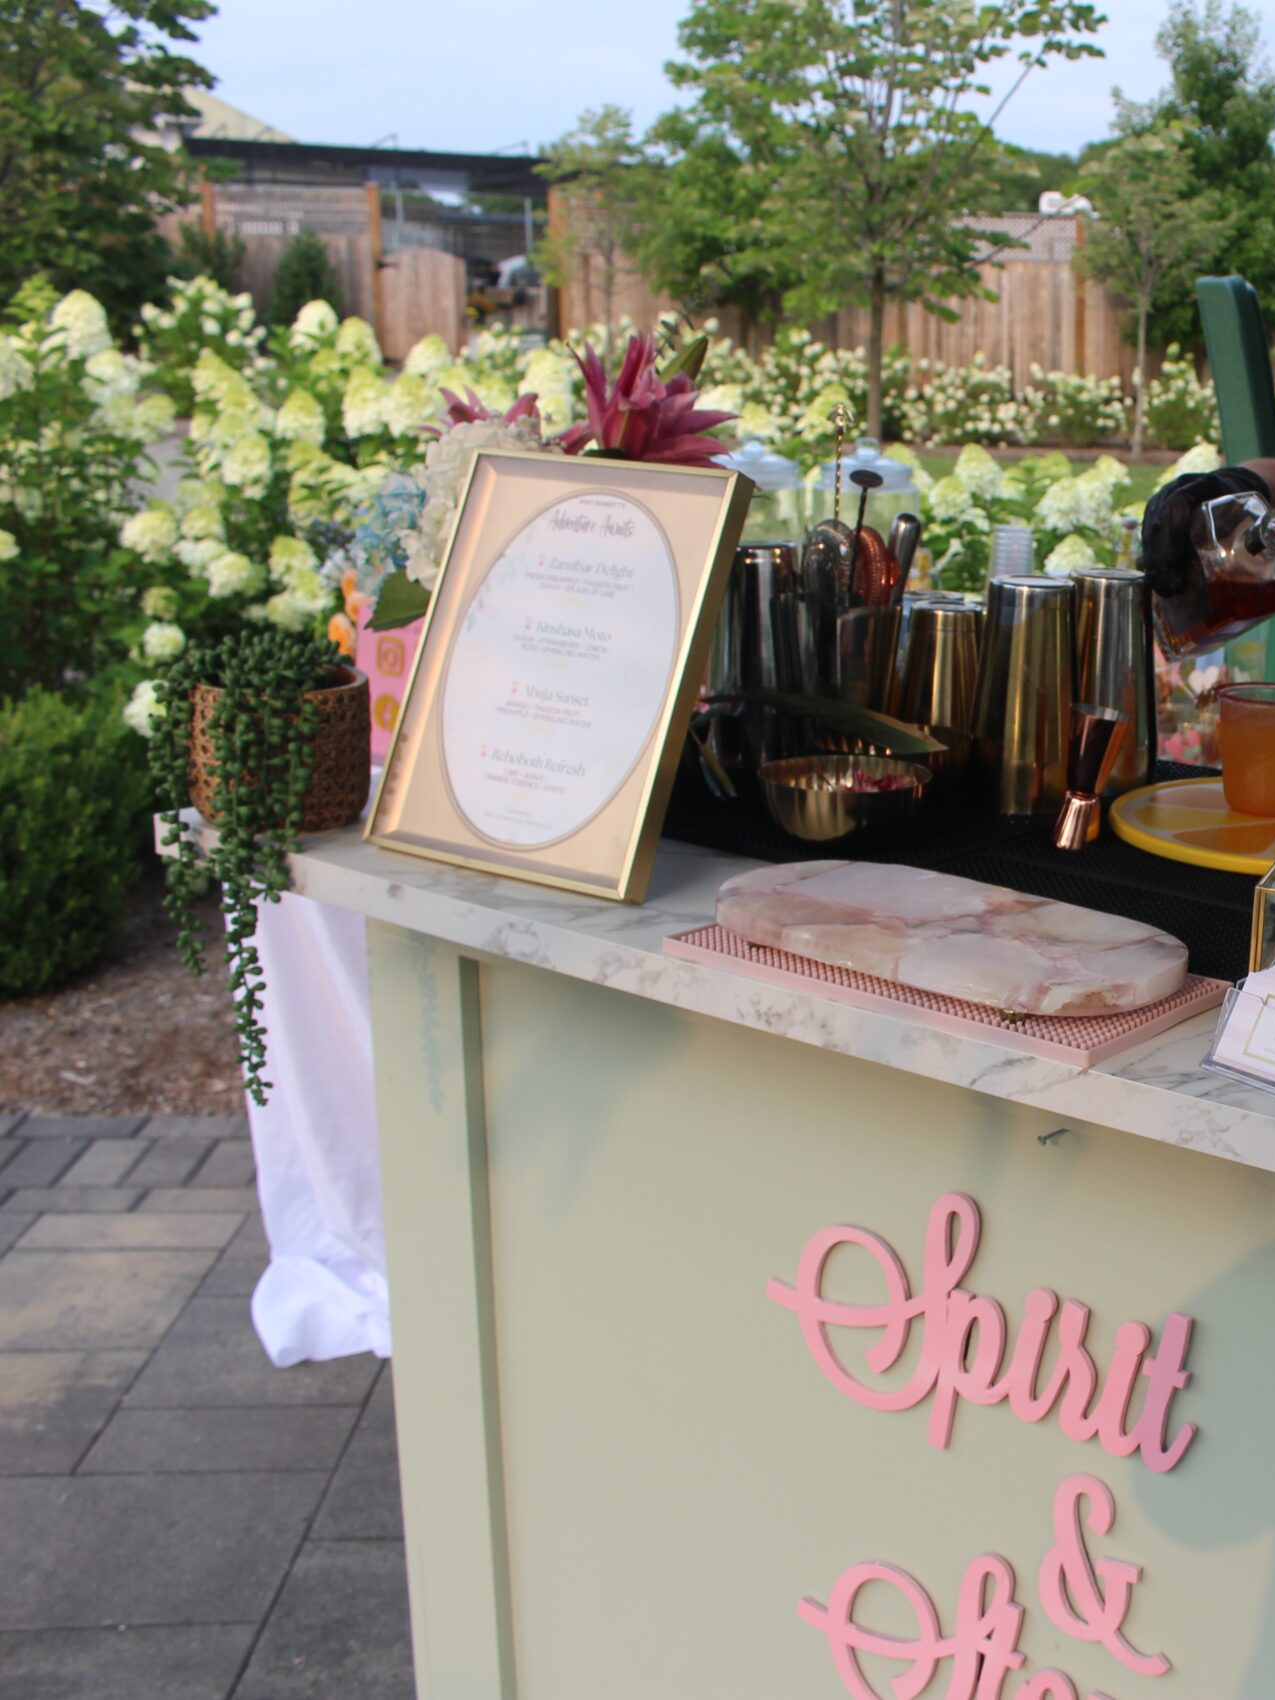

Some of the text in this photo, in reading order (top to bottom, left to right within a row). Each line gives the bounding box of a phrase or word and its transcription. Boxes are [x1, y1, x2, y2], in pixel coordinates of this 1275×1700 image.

[595, 562, 634, 580] Delight
[765, 1191, 1198, 1473] Spirit
[1038, 1473, 1170, 1677] &
